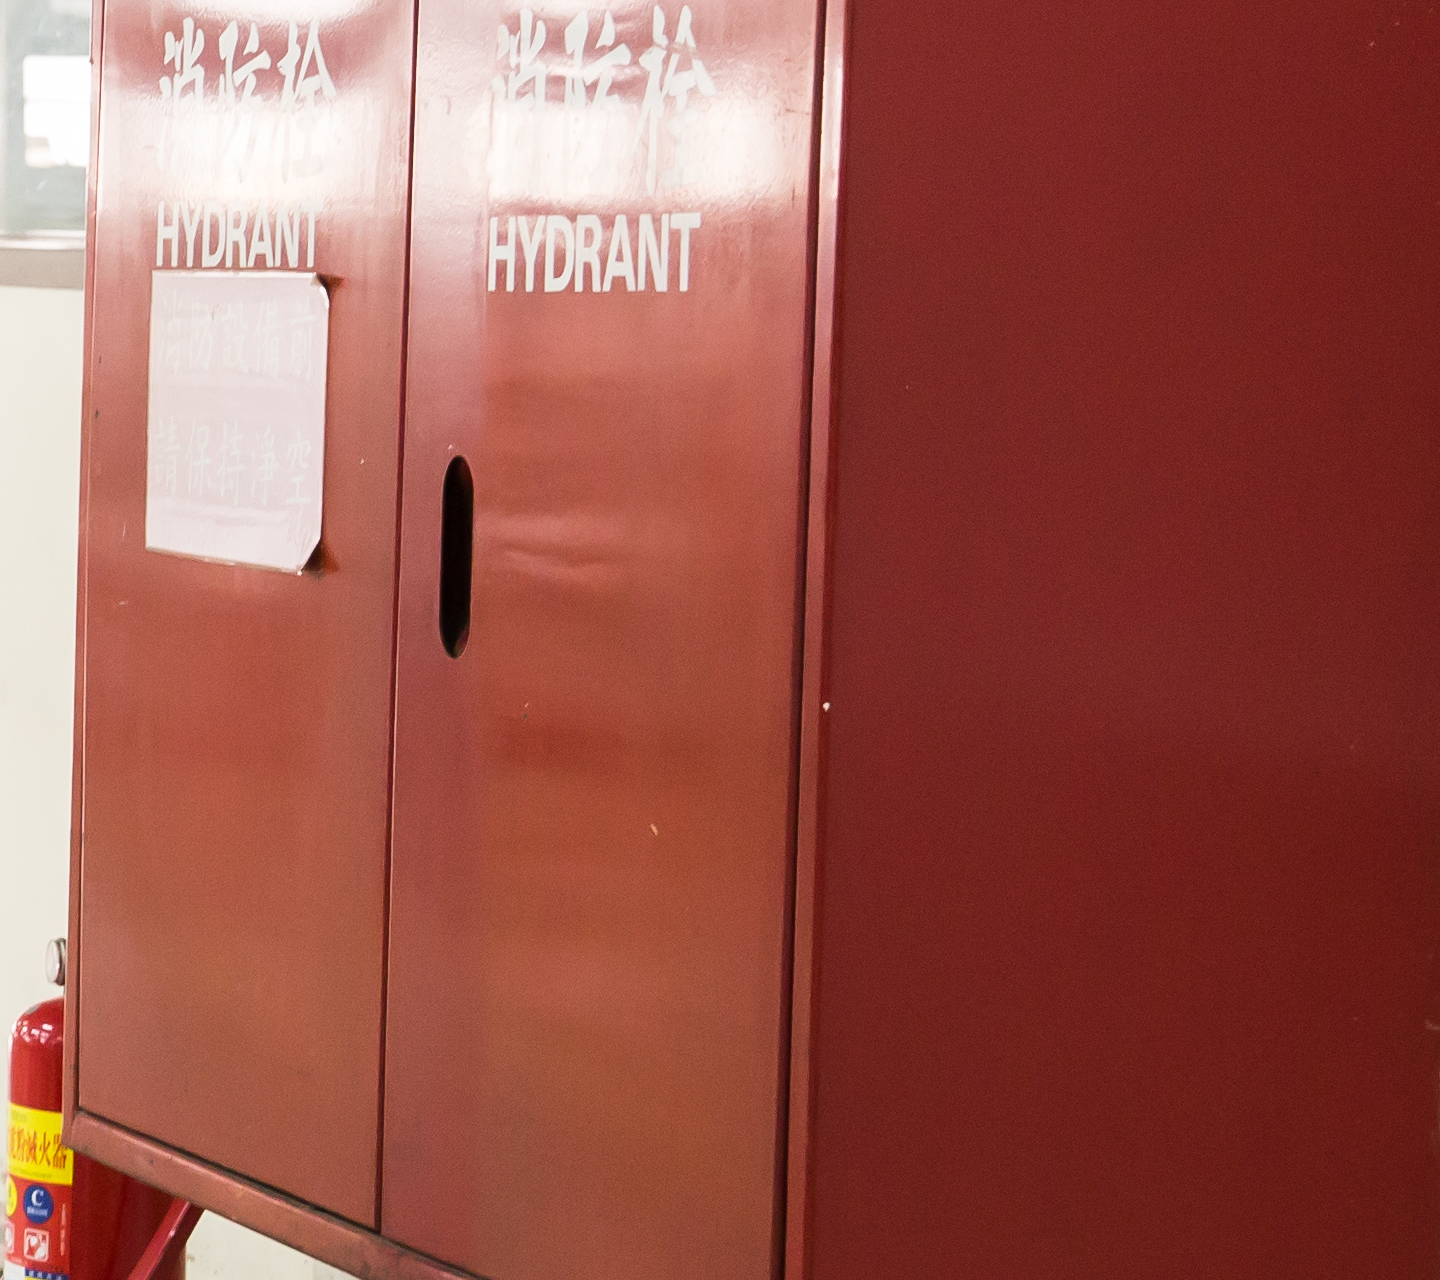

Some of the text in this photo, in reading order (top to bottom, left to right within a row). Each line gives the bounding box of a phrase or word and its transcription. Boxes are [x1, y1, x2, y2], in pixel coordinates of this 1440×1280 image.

[155, 201, 324, 268] HYDRANT
[487, 212, 701, 293] HYDRANT
[31, 1188, 45, 1207] C
